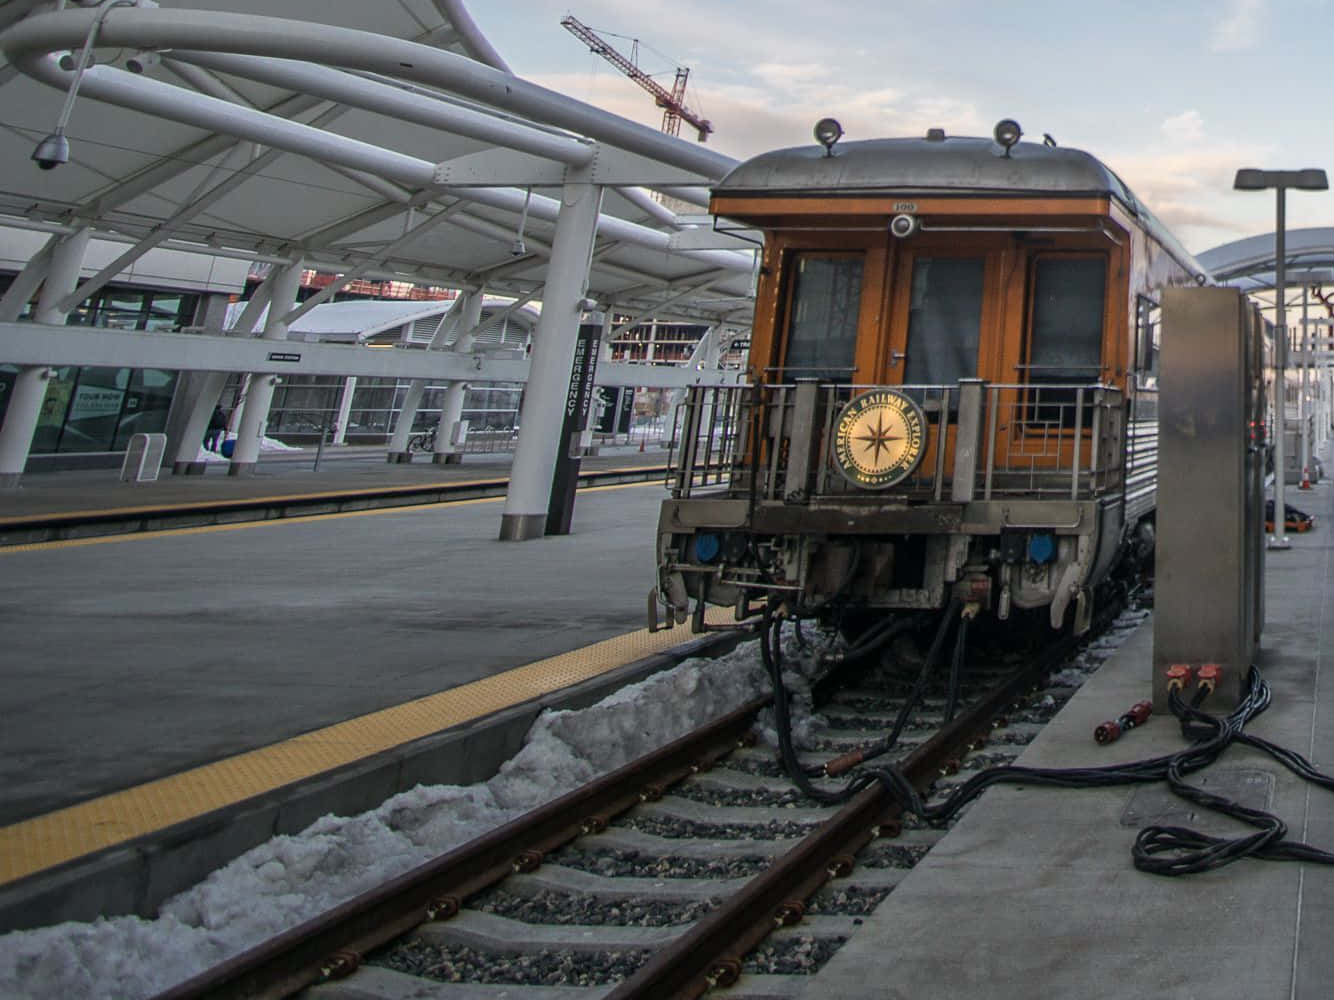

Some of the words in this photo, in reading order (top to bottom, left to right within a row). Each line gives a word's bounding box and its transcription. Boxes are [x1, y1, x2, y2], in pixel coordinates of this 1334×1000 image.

[567, 339, 586, 416] EMERGENCY
[582, 339, 599, 416] EMERGENCY
[836, 407, 858, 470] AMERICAN
[860, 393, 909, 411] RAILWAY
[901, 410, 921, 471] EXPLORER
